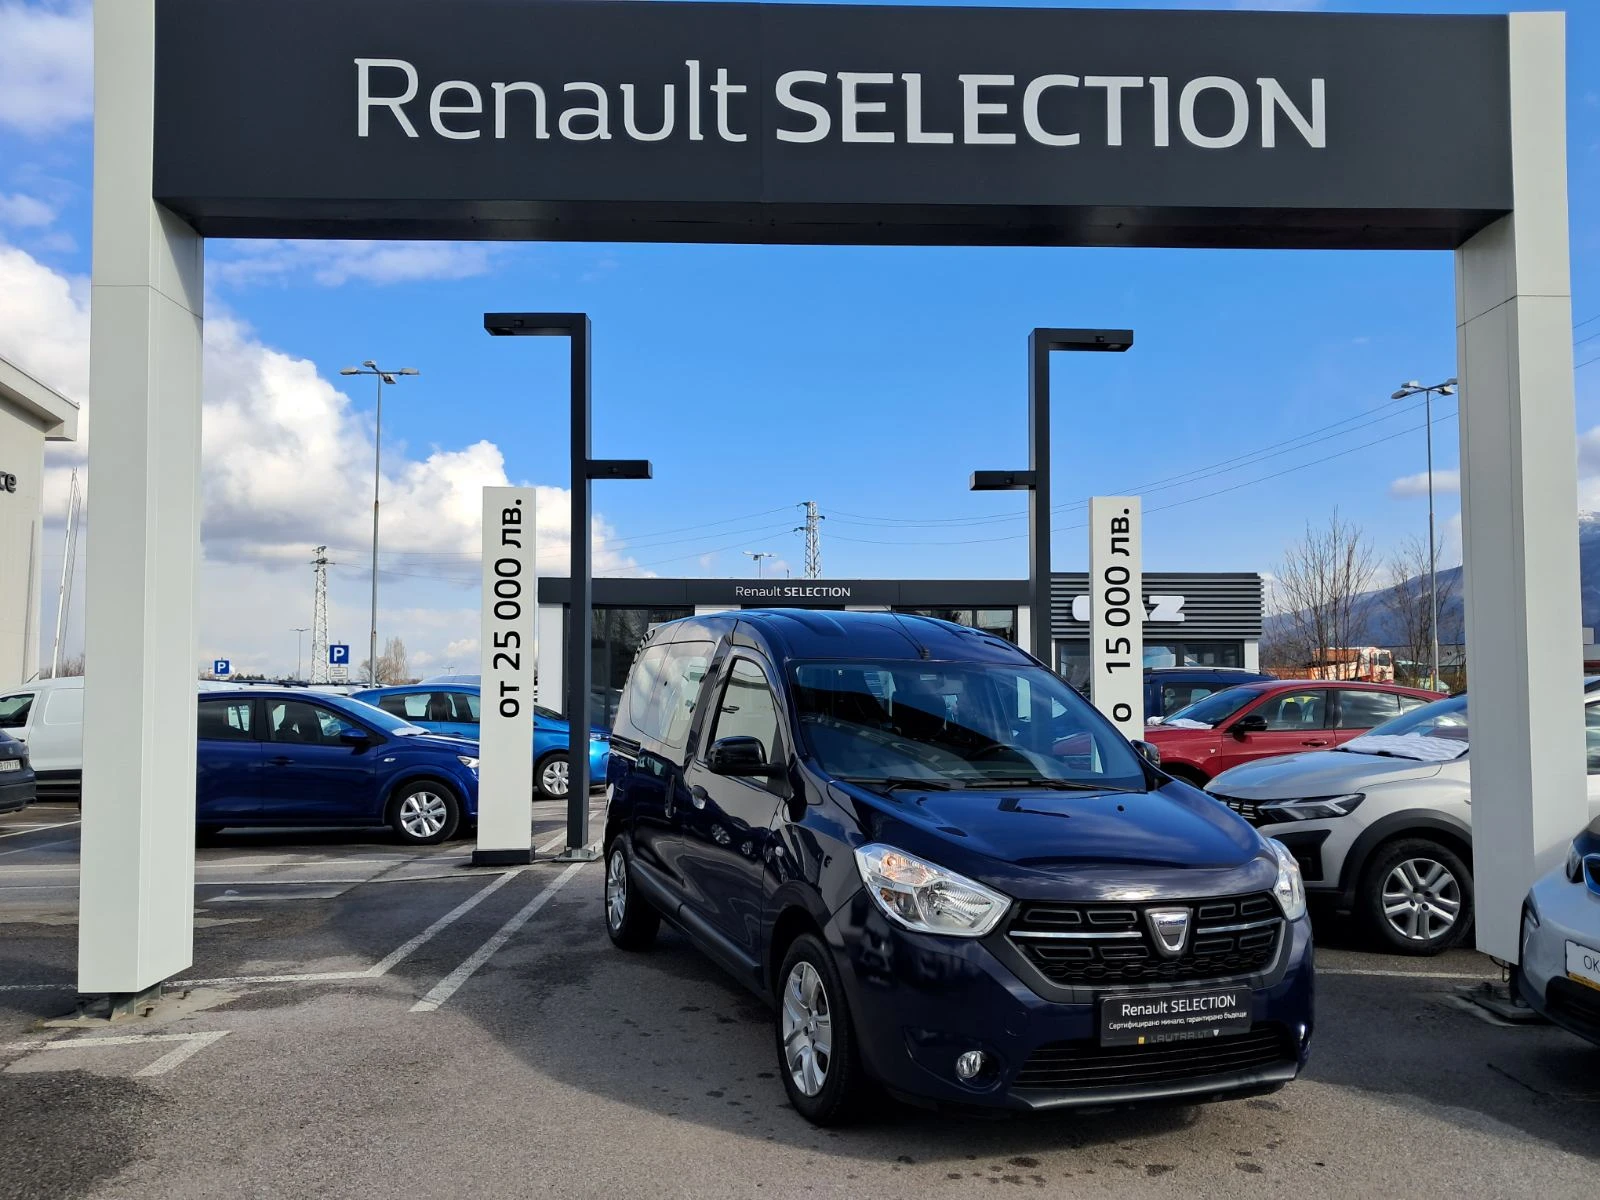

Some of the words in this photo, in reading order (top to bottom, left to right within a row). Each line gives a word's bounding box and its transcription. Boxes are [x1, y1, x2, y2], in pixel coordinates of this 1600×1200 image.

[353, 57, 747, 143] Renault
[775, 70, 1326, 150] SELECTION
[502, 499, 523, 549] лв.
[1111, 508, 1130, 557] лв.
[494, 558, 522, 620] 000
[735, 586, 781, 597] Renault
[784, 587, 851, 597] SELECTION
[1104, 566, 1130, 627] 000
[217, 662, 226, 673] P
[333, 647, 345, 662] P
[493, 631, 521, 671] 25
[1106, 638, 1131, 674] 15
[499, 681, 520, 718] от
[1122, 1001, 1168, 1017] Renault
[1171, 994, 1236, 1013] SELECTION
